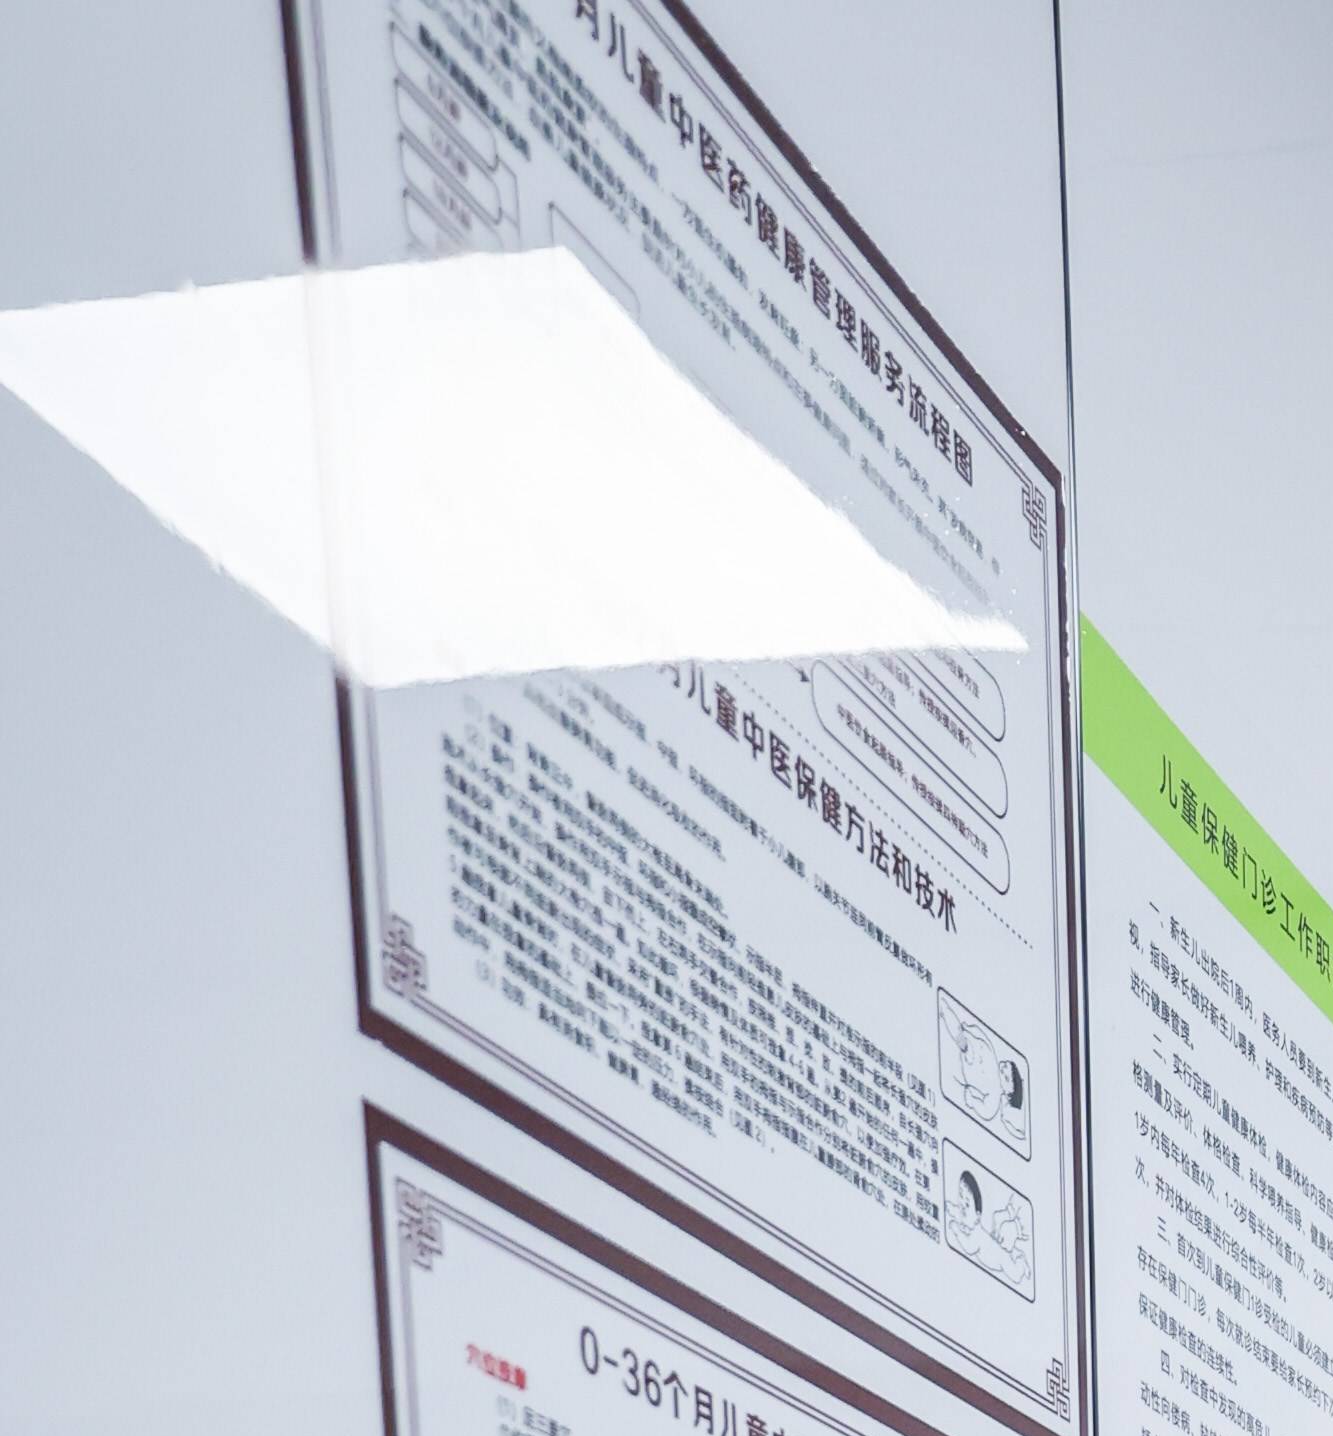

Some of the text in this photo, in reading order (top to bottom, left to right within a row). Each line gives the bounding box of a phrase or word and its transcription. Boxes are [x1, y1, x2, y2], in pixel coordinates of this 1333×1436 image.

[1129, 965, 1194, 1053] 进行健康管理。
[1137, 1289, 1237, 1387] 保证健康检查的连续性。
